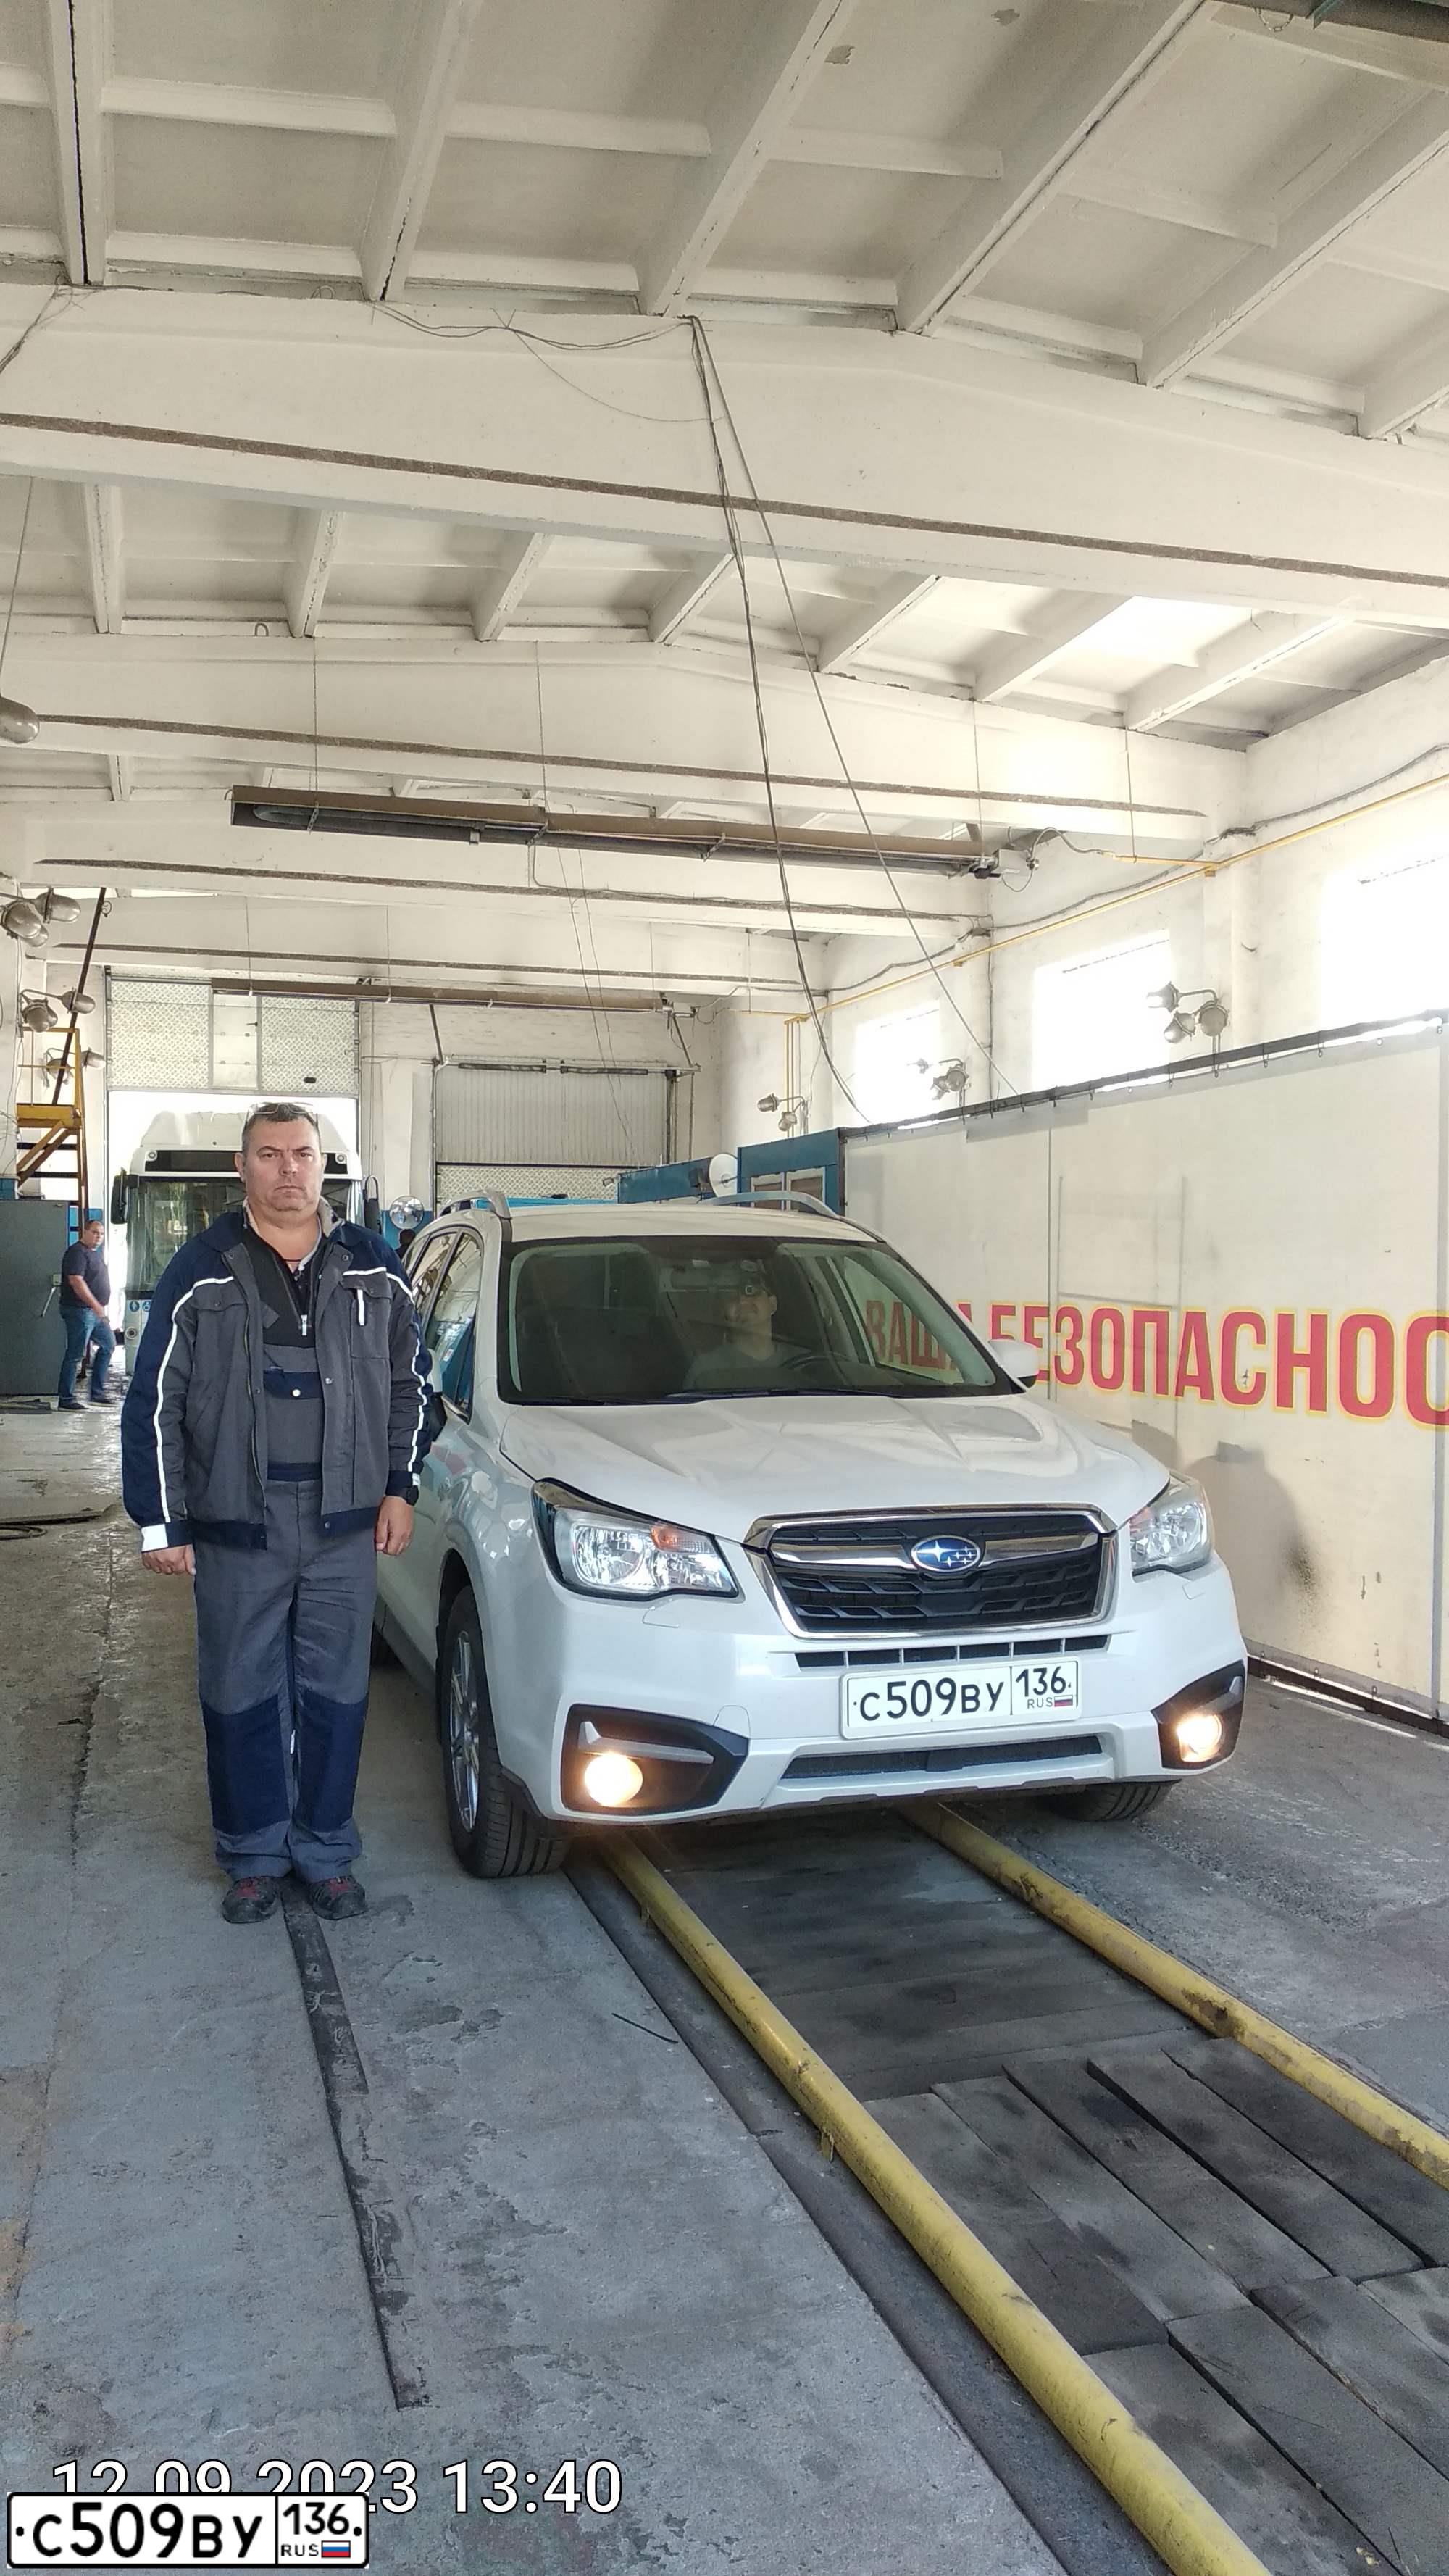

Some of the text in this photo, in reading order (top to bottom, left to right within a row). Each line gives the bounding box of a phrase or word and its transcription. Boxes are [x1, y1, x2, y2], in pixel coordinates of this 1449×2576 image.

[866, 1299, 974, 1370] ВАШ
[860, 1666, 1066, 1722] С509ВУ 136
[1027, 1697, 1053, 1709] RUS
